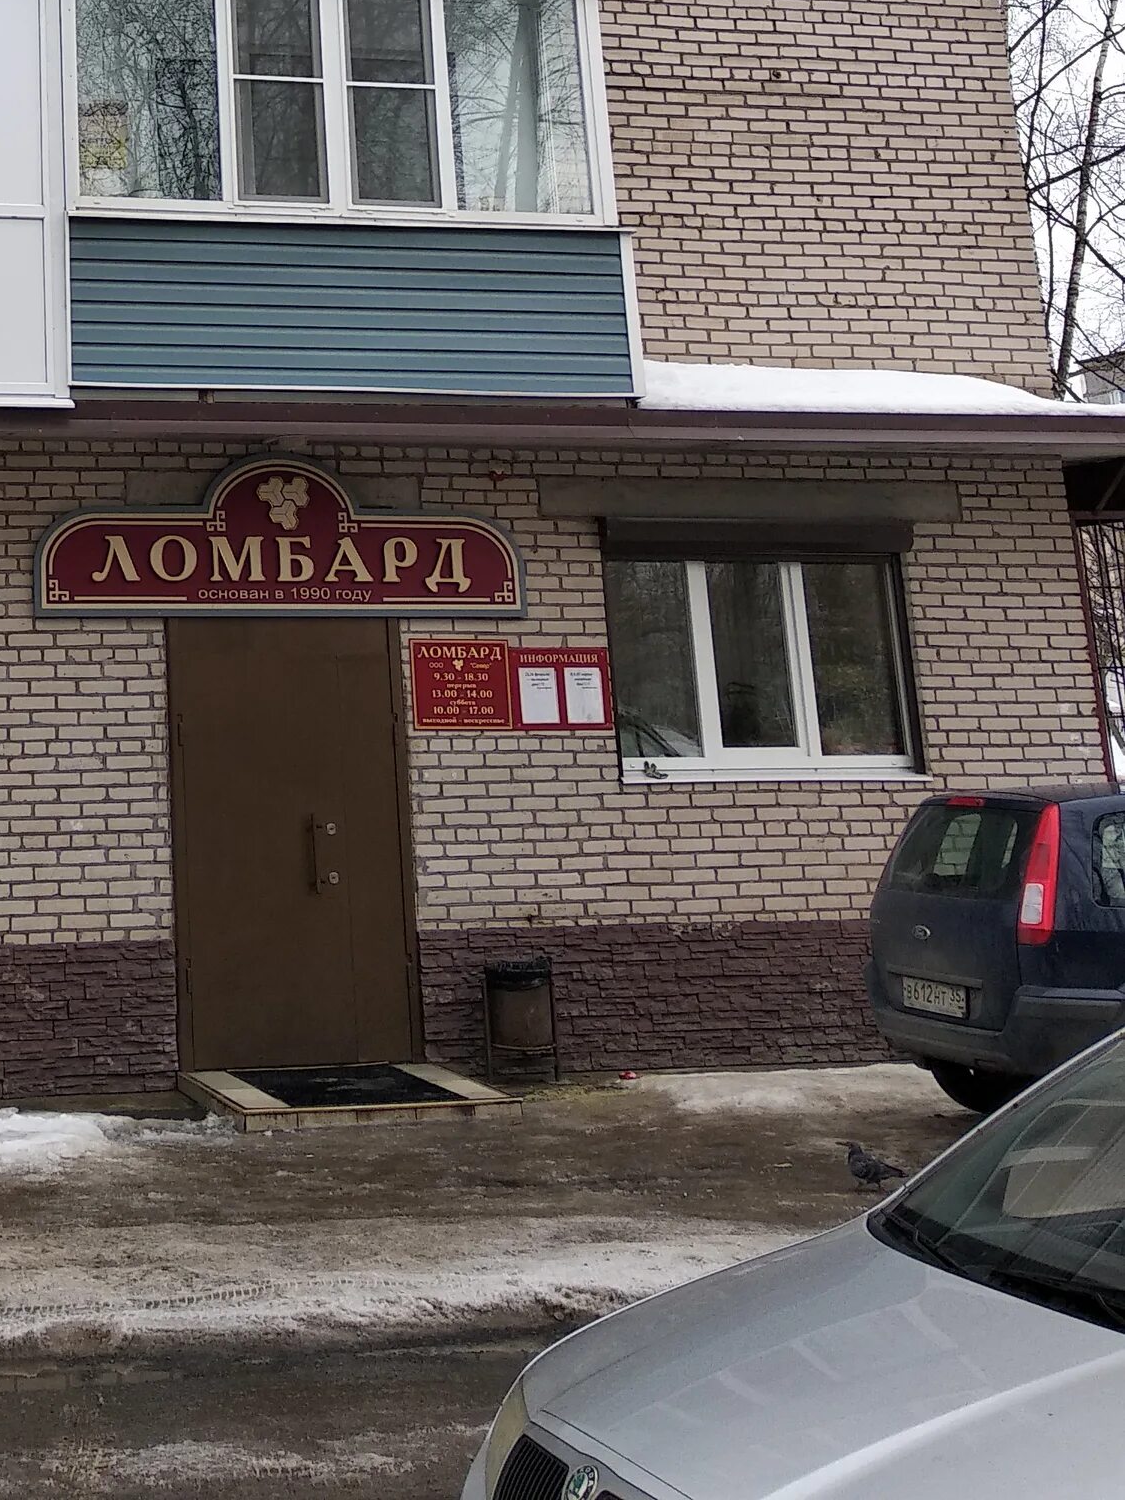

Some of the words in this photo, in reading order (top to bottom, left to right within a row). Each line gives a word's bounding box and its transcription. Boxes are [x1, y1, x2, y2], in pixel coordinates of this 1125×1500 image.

[91, 534, 472, 593] ЛОМБАРД
[198, 588, 269, 600] основан
[274, 588, 284, 600] в
[290, 587, 331, 600] 1990
[335, 589, 372, 602] году
[417, 646, 502, 660] ЛОМБАРД
[520, 654, 599, 664] ИНФОРМАЦИЯ
[433, 672, 455, 680] 9.30
[464, 672, 488, 680] 18.30
[432, 689, 457, 698] 13.00
[467, 689, 493, 698] 14.00
[433, 706, 459, 715] 10.00
[469, 706, 494, 715] 17.00
